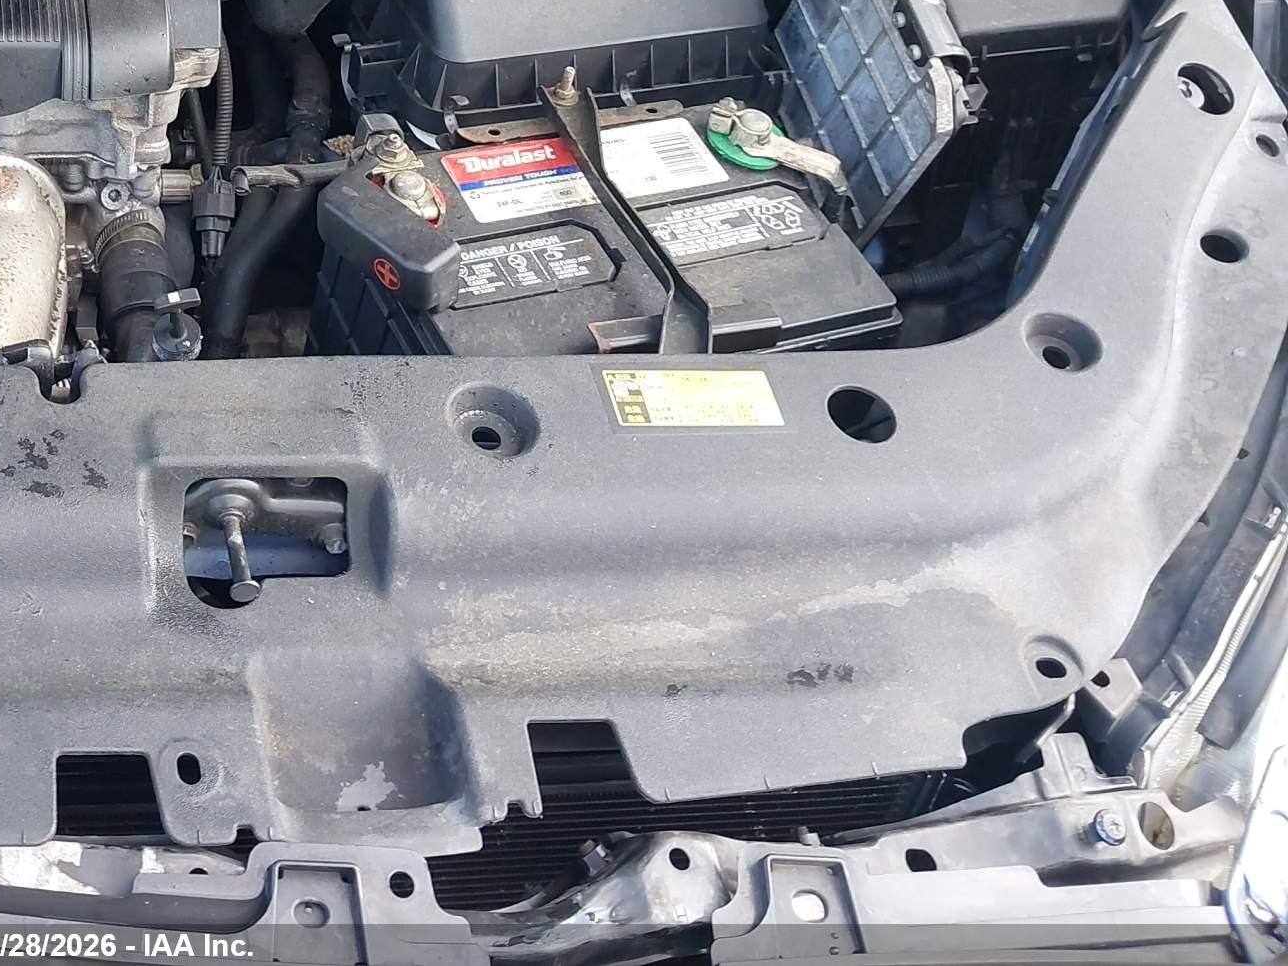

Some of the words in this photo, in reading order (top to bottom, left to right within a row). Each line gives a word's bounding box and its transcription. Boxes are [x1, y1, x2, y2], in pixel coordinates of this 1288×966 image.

[456, 144, 557, 174] Duralast
[483, 175, 523, 186] PROVEN
[523, 169, 558, 181] TOUGH
[461, 244, 508, 260] DANGER
[517, 235, 561, 250] POISON
